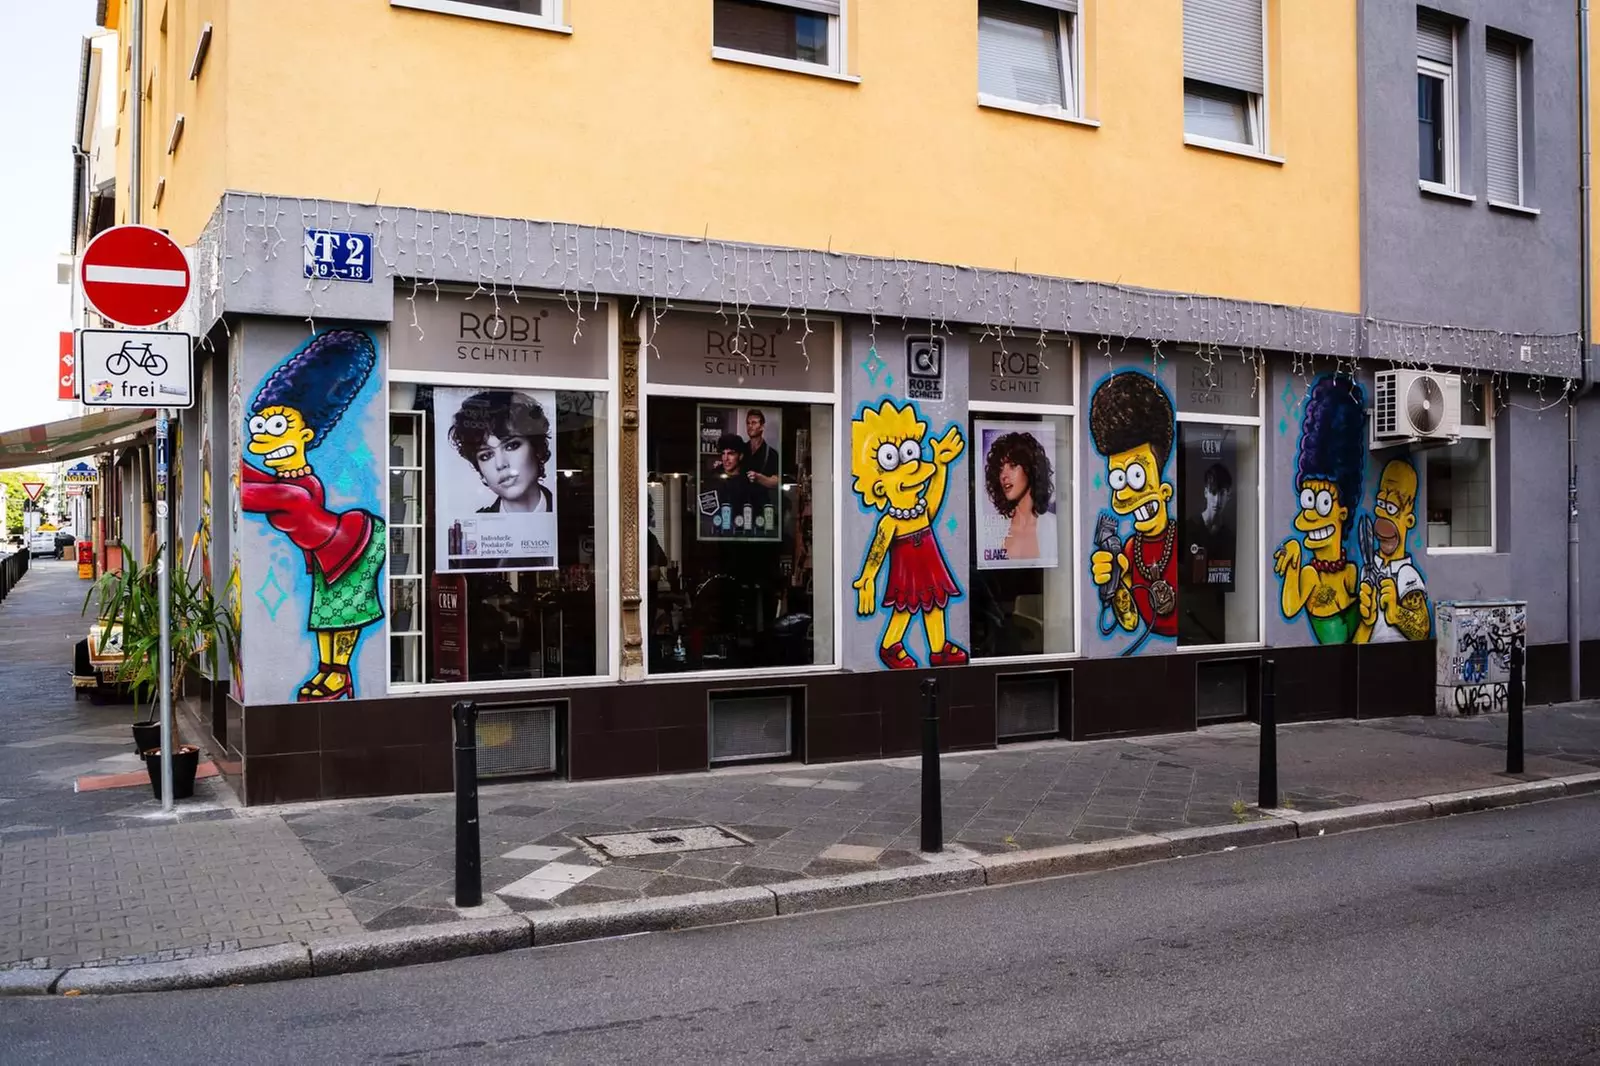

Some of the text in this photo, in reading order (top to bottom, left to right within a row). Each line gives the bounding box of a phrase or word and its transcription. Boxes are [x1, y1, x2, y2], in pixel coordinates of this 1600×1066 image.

[314, 233, 364, 265] T 2
[350, 266, 363, 278] 13
[460, 311, 541, 342] ROBI
[707, 329, 776, 358] ROBI
[457, 346, 542, 362] SCHNITT
[704, 361, 777, 376] SCHNITT
[121, 381, 155, 397] frei
[908, 379, 940, 391] ROBI
[908, 390, 943, 399] SCHNITT
[1201, 440, 1222, 454] CREW
[438, 593, 458, 609] CREW
